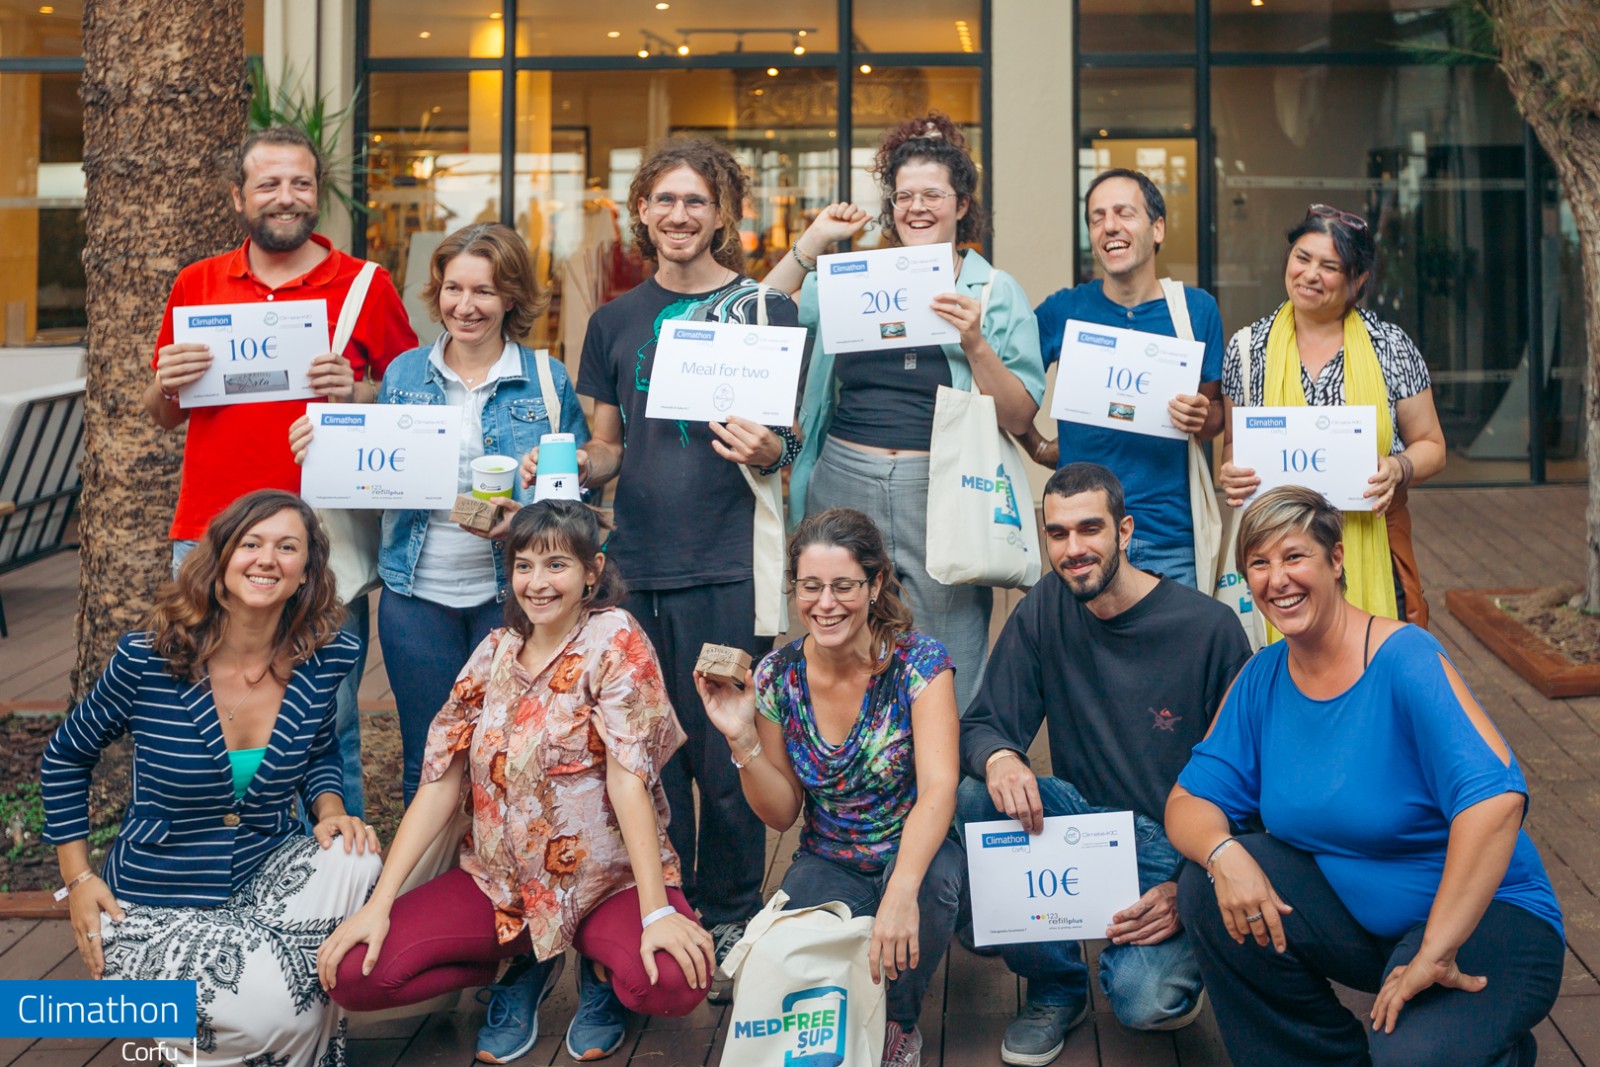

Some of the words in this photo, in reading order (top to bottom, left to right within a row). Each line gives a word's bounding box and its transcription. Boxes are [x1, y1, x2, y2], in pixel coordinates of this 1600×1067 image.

[832, 263, 866, 273] Climathon
[861, 288, 909, 315] 20€
[191, 317, 229, 327] Climathon
[676, 330, 712, 340] Climathon
[1079, 333, 1115, 346] Climathon
[228, 335, 279, 362] 10€
[681, 361, 717, 376] Meal
[719, 363, 740, 377] for
[742, 366, 769, 379] two
[1105, 366, 1152, 395] 10€
[324, 415, 362, 425] Climathon
[1249, 418, 1283, 427] Climathon
[355, 447, 406, 472] 10€
[1280, 448, 1327, 473] 10€
[985, 834, 1026, 846] Climathon
[1024, 866, 1080, 899] 10€
[1046, 912, 1059, 920] 123
[1048, 917, 1084, 925] refillplus
[734, 1009, 836, 1039] MEDFREE
[797, 1028, 834, 1049] SUP
